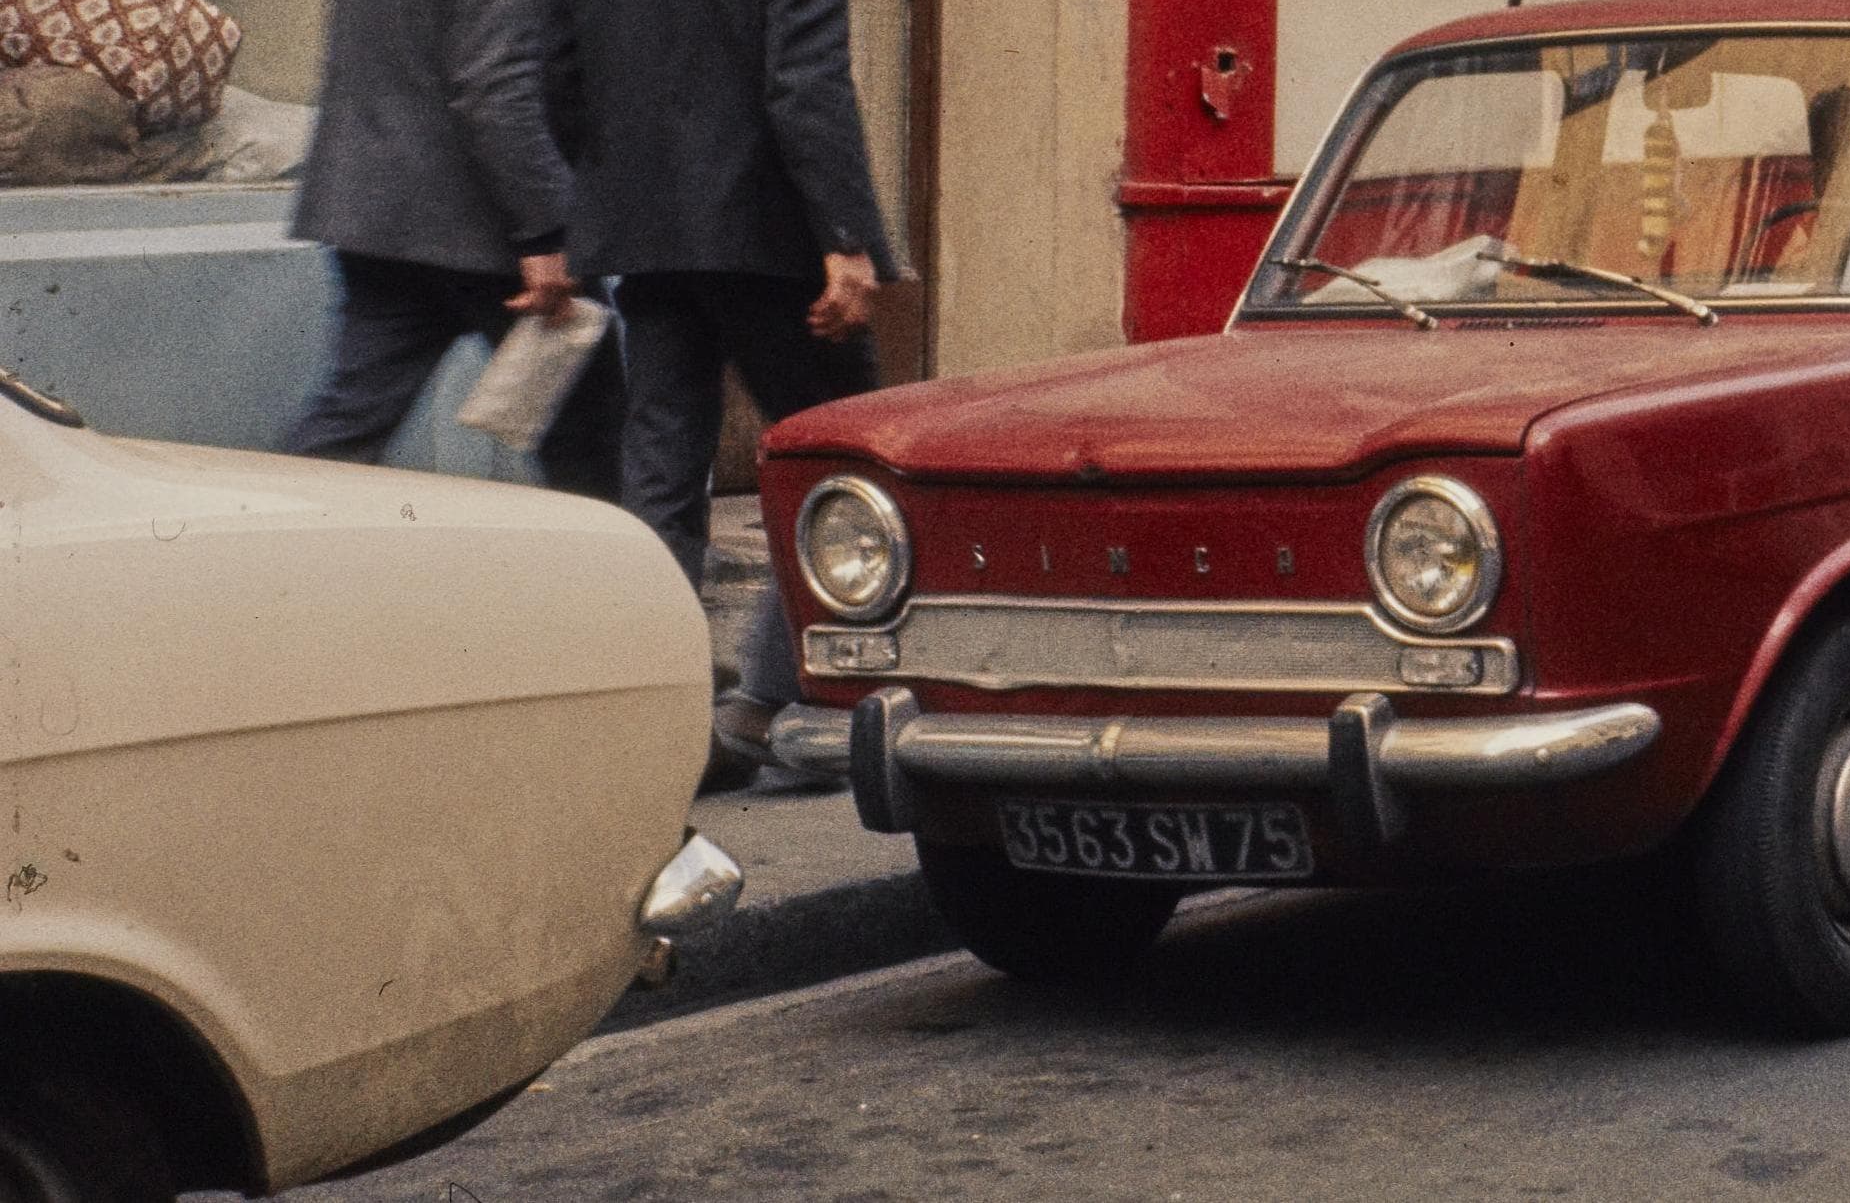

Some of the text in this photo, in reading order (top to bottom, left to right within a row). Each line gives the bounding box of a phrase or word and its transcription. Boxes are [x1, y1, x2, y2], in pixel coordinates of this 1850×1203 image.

[973, 544, 1294, 575] SIMCA
[1004, 803, 1300, 871] 3563 SW 75
